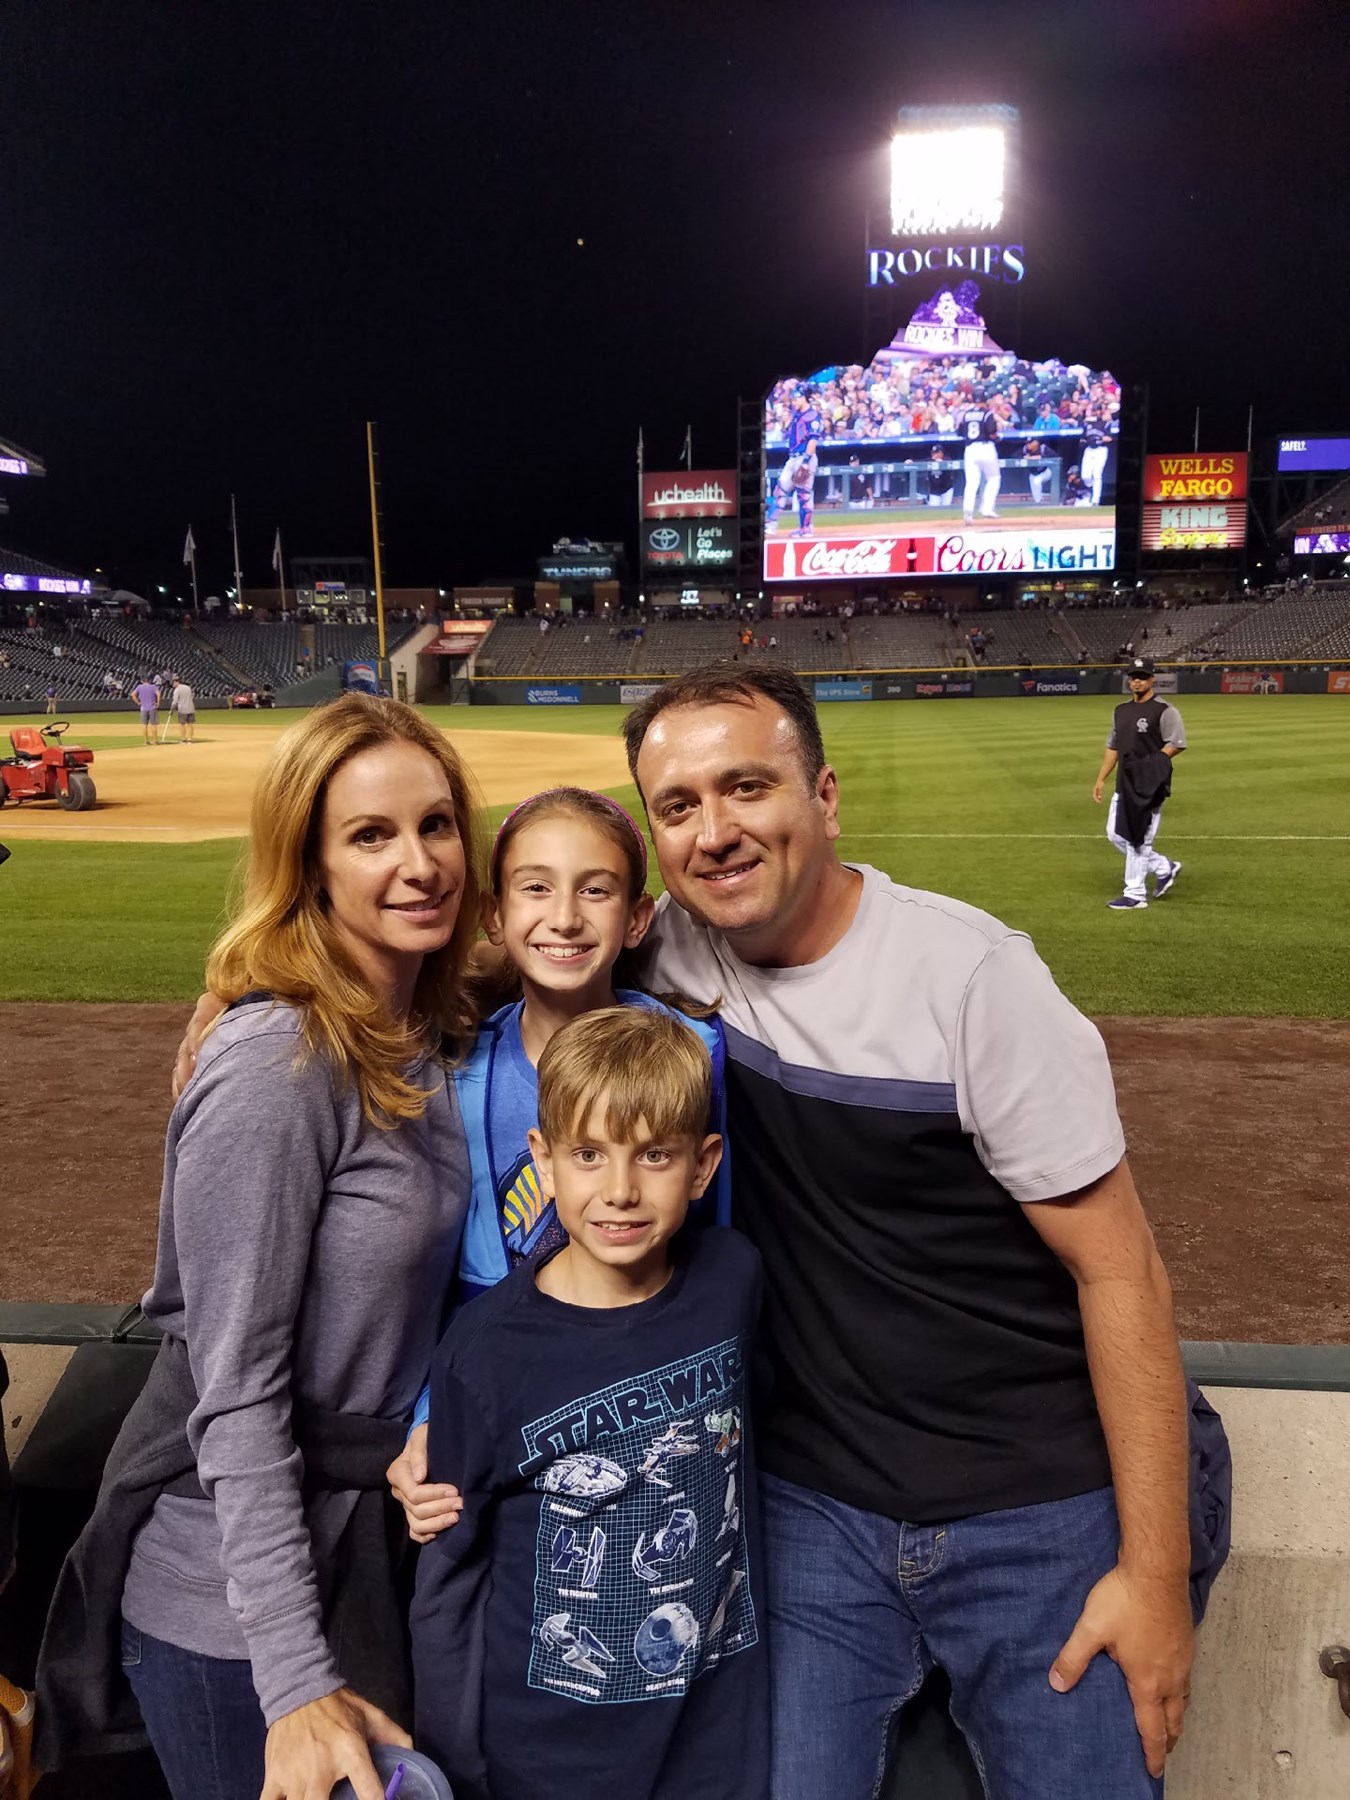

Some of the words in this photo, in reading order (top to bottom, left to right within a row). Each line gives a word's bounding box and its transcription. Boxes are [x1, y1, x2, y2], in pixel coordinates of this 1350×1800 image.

[865, 244, 1025, 288] ROCKIES
[904, 325, 954, 347] ROCKIES
[958, 328, 984, 348] WIN
[1159, 459, 1234, 475] WELLS
[654, 481, 725, 503] uchealth
[1159, 478, 1233, 497] FARGO
[1160, 507, 1228, 528] KING
[697, 526, 722, 537] Let's
[696, 538, 713, 549] Go
[647, 551, 684, 560] TOYOTA
[696, 549, 734, 560] Places
[937, 536, 1025, 573] Coors
[1033, 544, 1112, 569] LIGHT
[815, 689, 828, 697] The
[1036, 682, 1078, 693] Fanatics
[518, 1387, 666, 1476] STAR
[658, 1348, 743, 1413] WAR
[557, 1588, 569, 1597] TIE
[569, 1590, 598, 1599] FIGHTER
[649, 1586, 661, 1595] TIE
[667, 1677, 685, 1687] STAR
